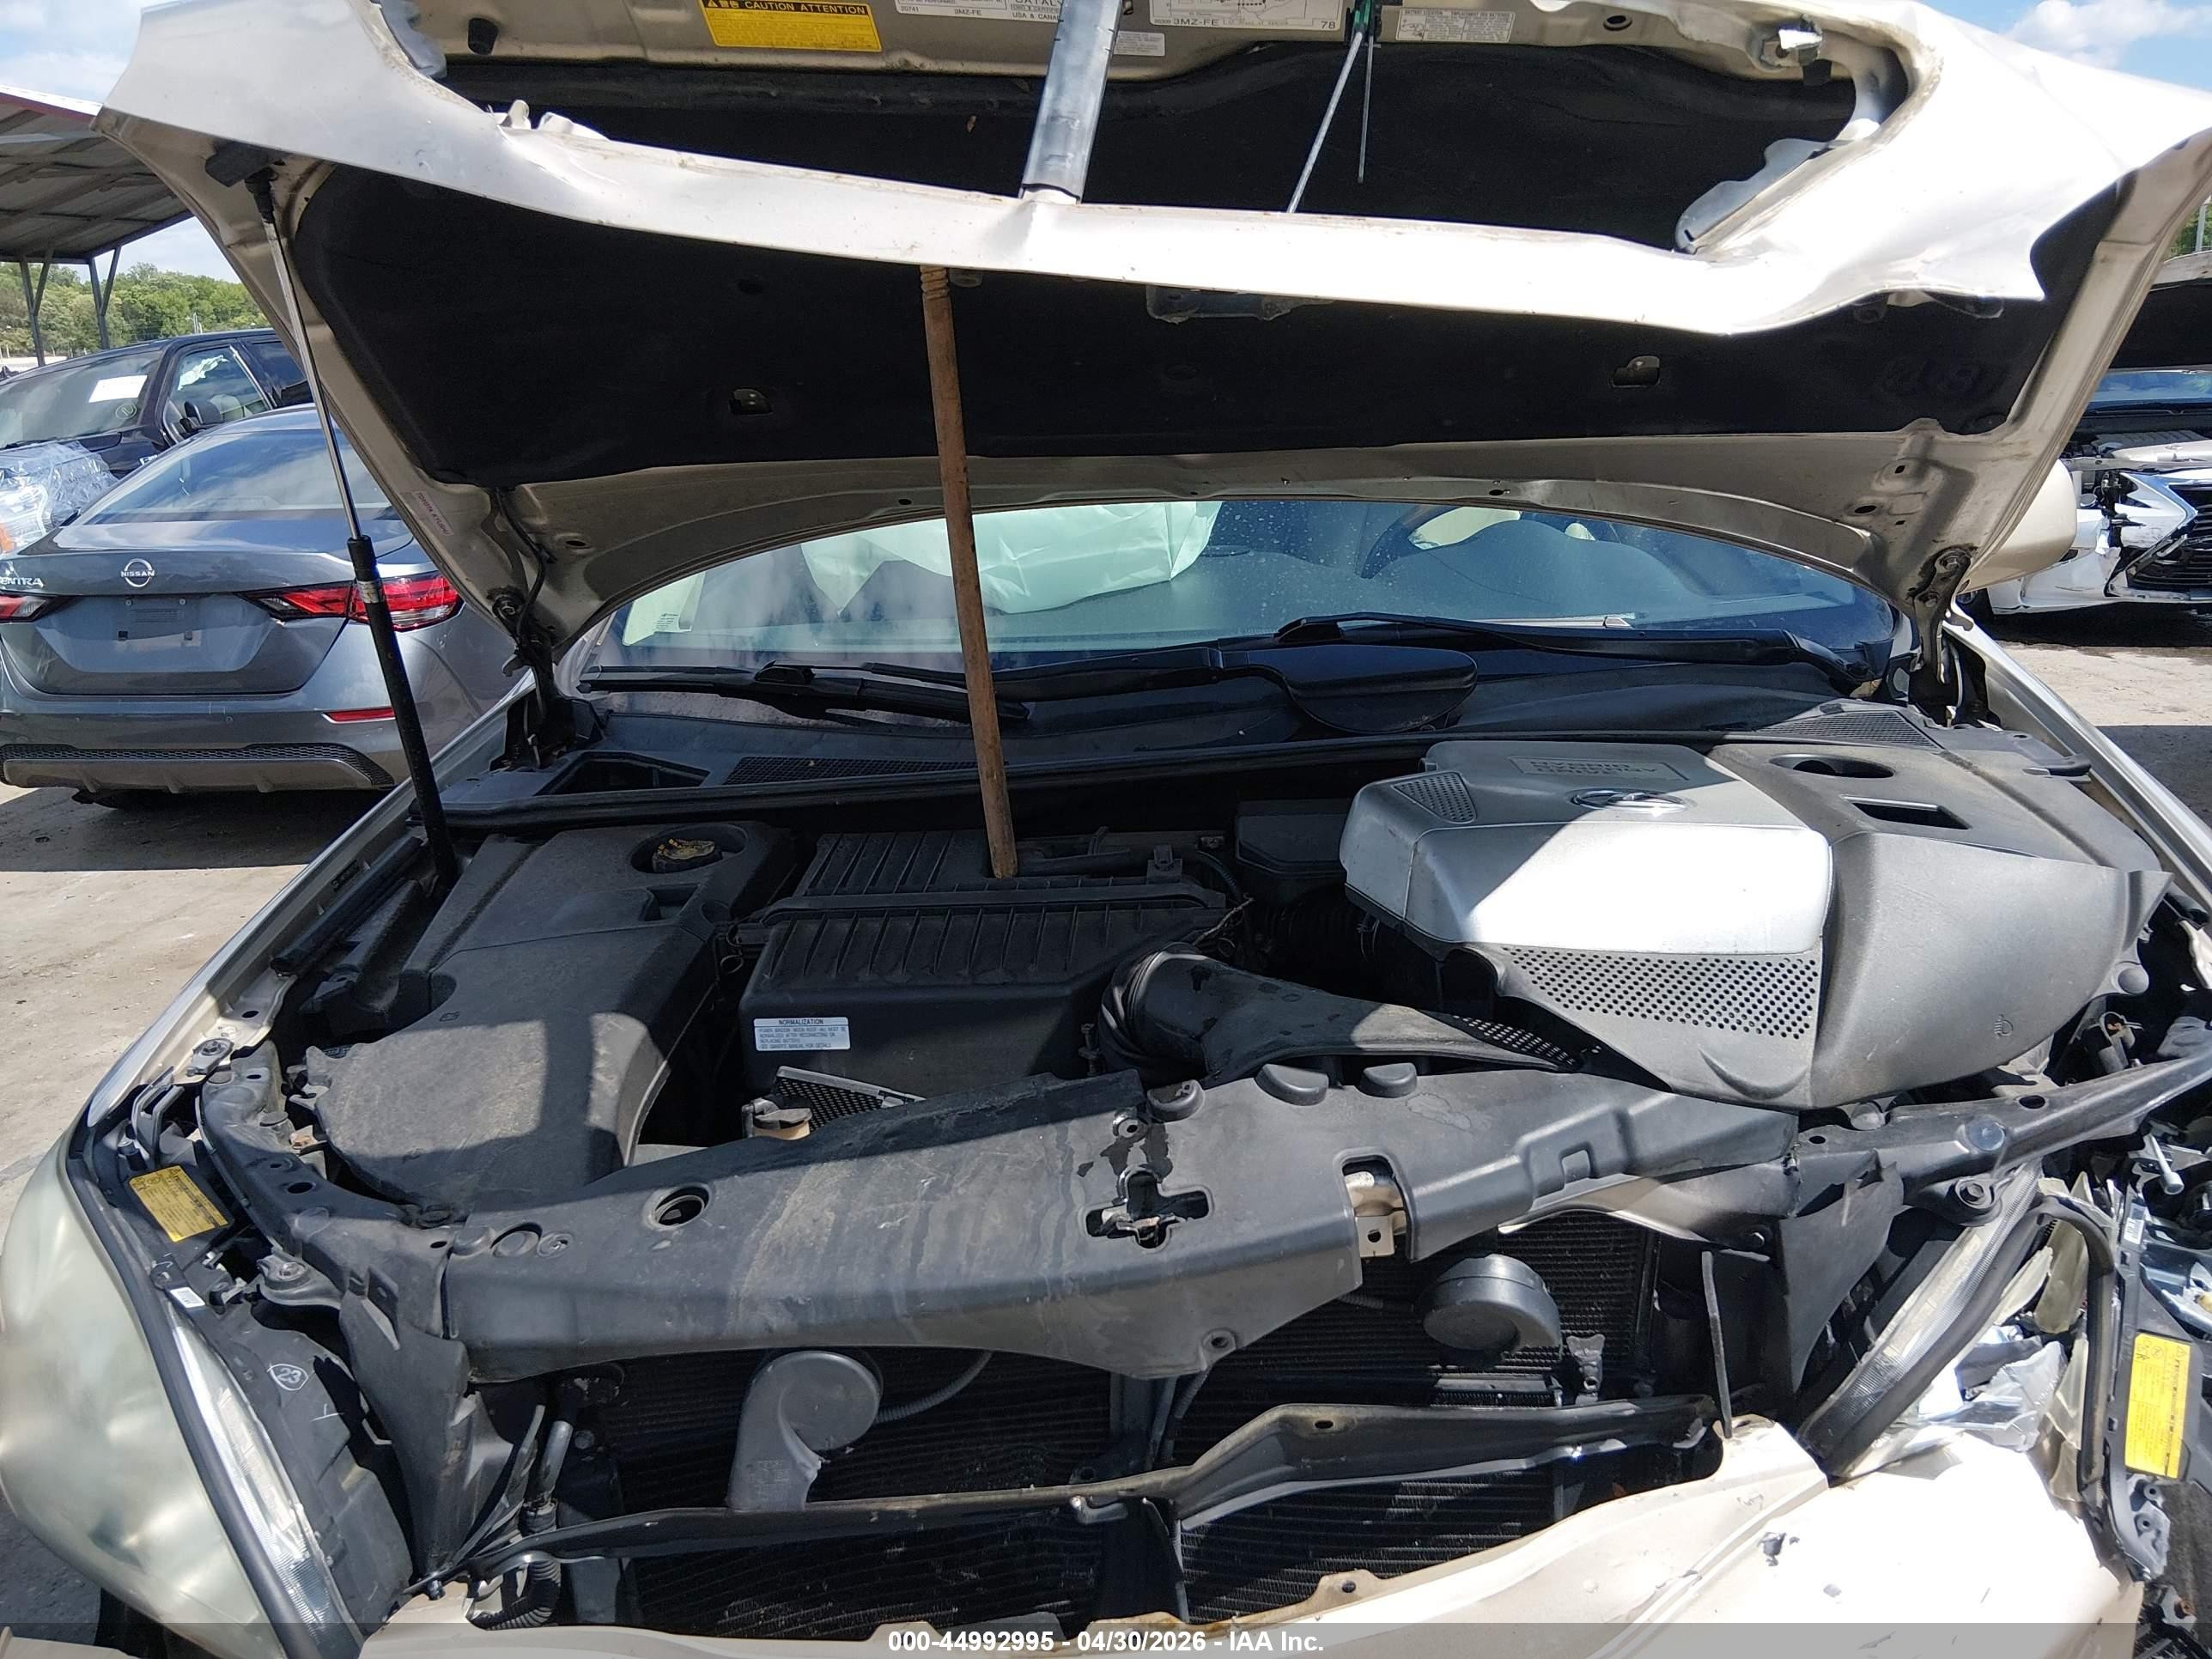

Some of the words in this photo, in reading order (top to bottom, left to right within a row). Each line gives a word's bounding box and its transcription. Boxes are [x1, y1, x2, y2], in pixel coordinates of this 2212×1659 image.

[744, 1, 795, 11] CAUTION
[800, 3, 866, 15] ATTENTION
[1173, 18, 1218, 27] 3MZ-FE
[1321, 21, 1336, 29] 78
[0, 576, 45, 587] ENTRA
[276, 1366, 301, 1384] 23
